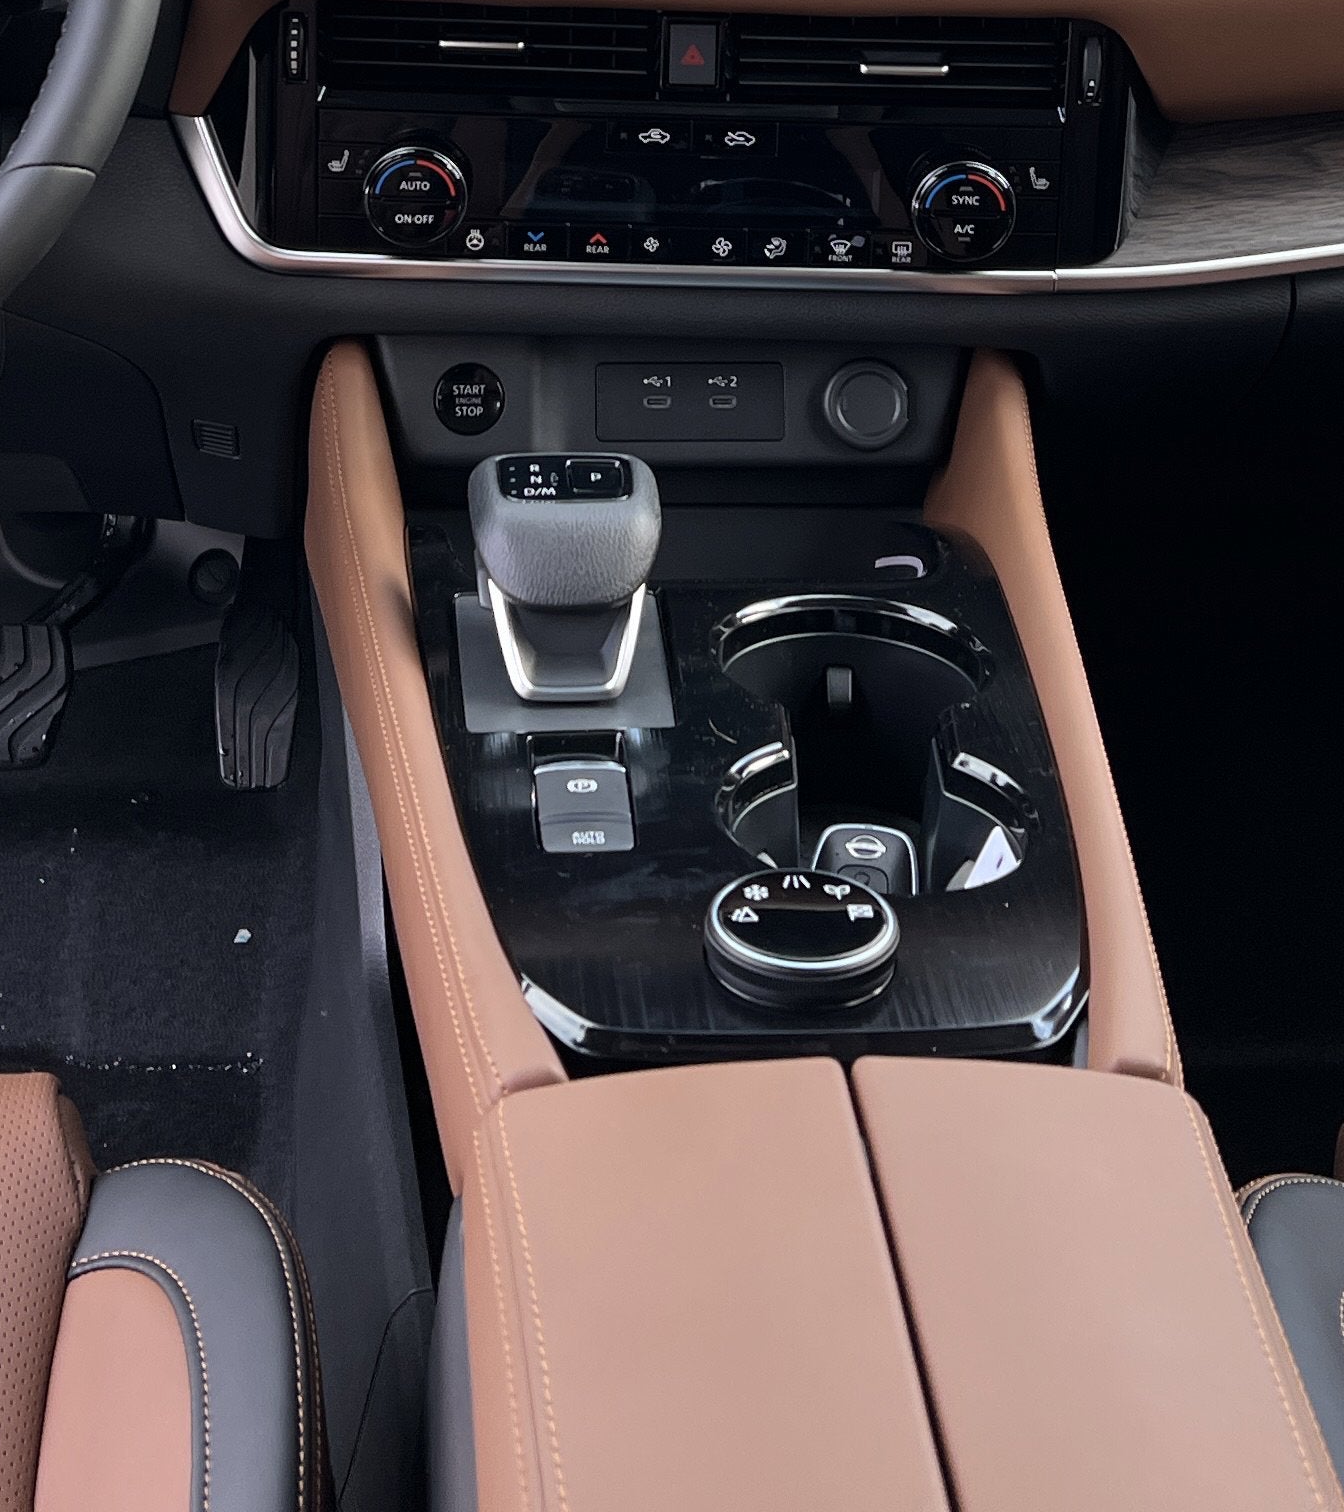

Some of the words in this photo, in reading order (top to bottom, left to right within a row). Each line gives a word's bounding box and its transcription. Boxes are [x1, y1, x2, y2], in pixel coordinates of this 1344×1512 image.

[399, 180, 430, 191] AUTO
[951, 194, 981, 206] SYNC
[953, 223, 975, 234] A/C
[523, 243, 547, 252] REAR
[585, 245, 610, 254] REAR
[828, 254, 853, 262] FRONT
[664, 376, 671, 387] 1
[729, 376, 738, 387] 2
[452, 384, 486, 395] START
[455, 396, 482, 405] ENGINE
[455, 406, 484, 417] STOP
[530, 475, 543, 484] N
[590, 472, 602, 482] P
[523, 487, 556, 497] D/M
